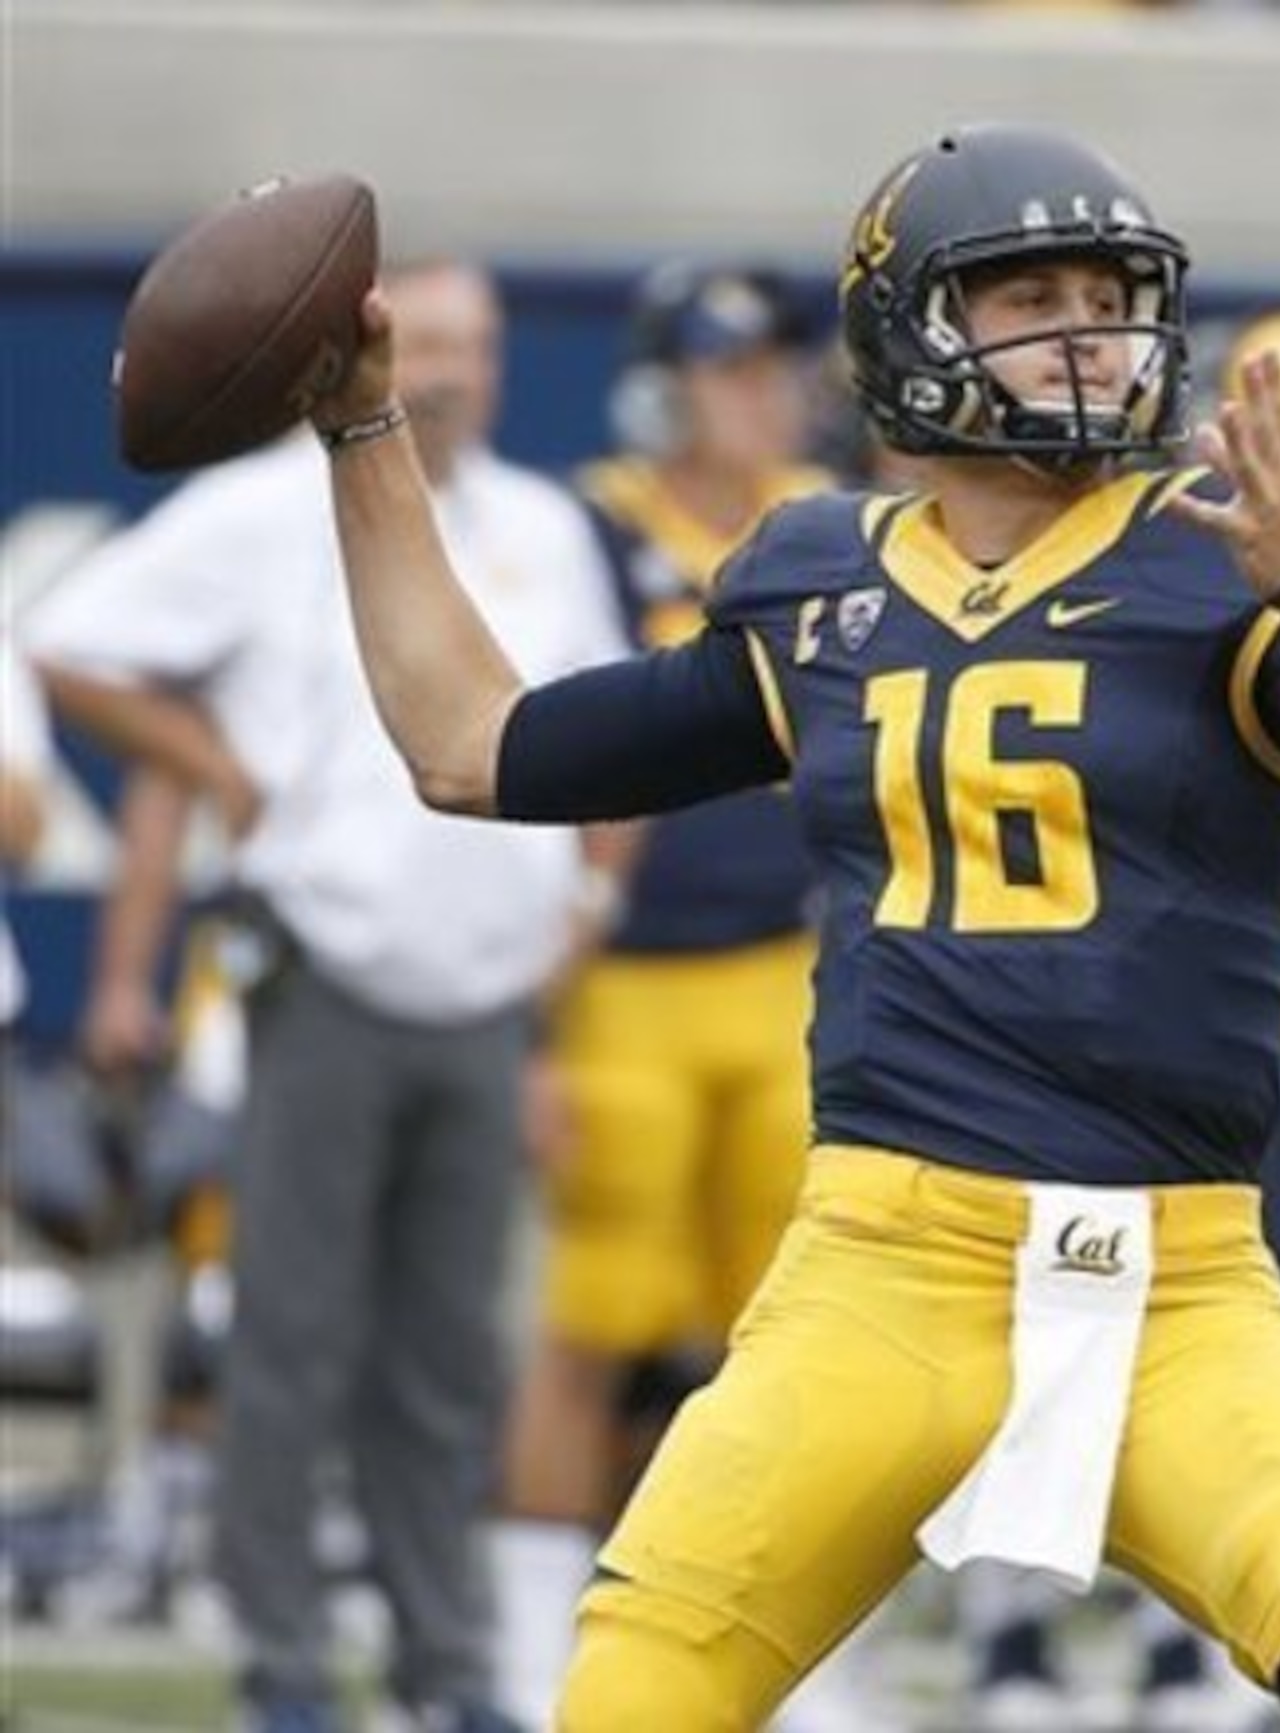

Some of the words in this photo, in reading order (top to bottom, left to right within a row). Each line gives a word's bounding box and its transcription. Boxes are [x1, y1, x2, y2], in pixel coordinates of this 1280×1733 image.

[961, 581, 1009, 615] Cal
[863, 659, 1098, 932] 16
[1050, 1216, 1130, 1276] Cal
